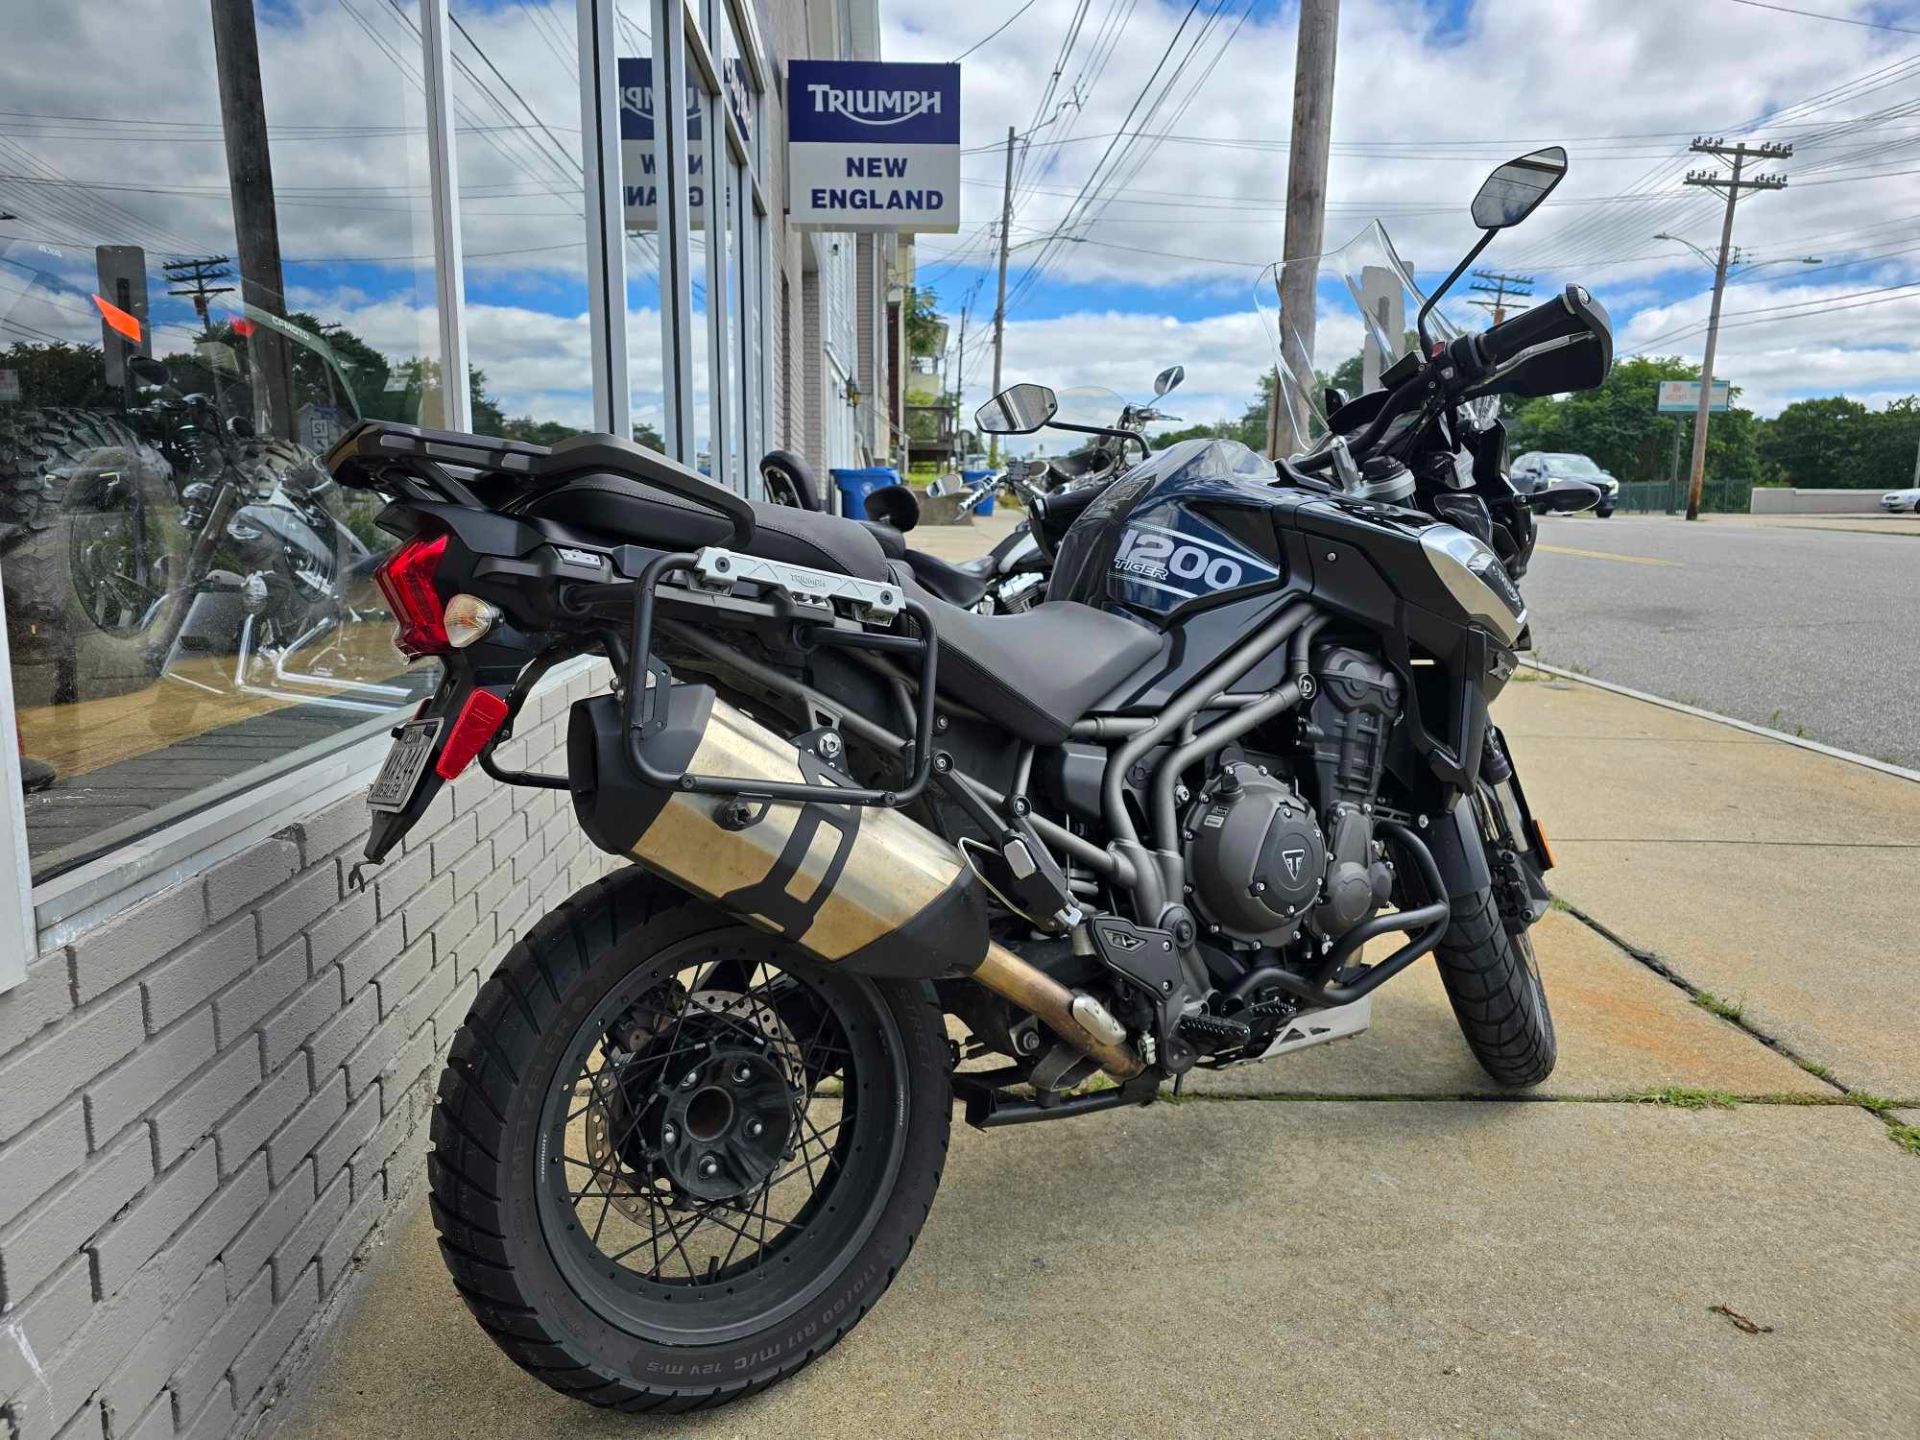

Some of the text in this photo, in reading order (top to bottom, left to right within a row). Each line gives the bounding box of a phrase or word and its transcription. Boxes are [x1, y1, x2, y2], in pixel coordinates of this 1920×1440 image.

[807, 84, 942, 125] TRIUMPH
[846, 157, 908, 178] NEW
[811, 189, 944, 210] ENGLAND
[1114, 558, 1169, 580] TIGER
[1115, 529, 1242, 590] 1200
